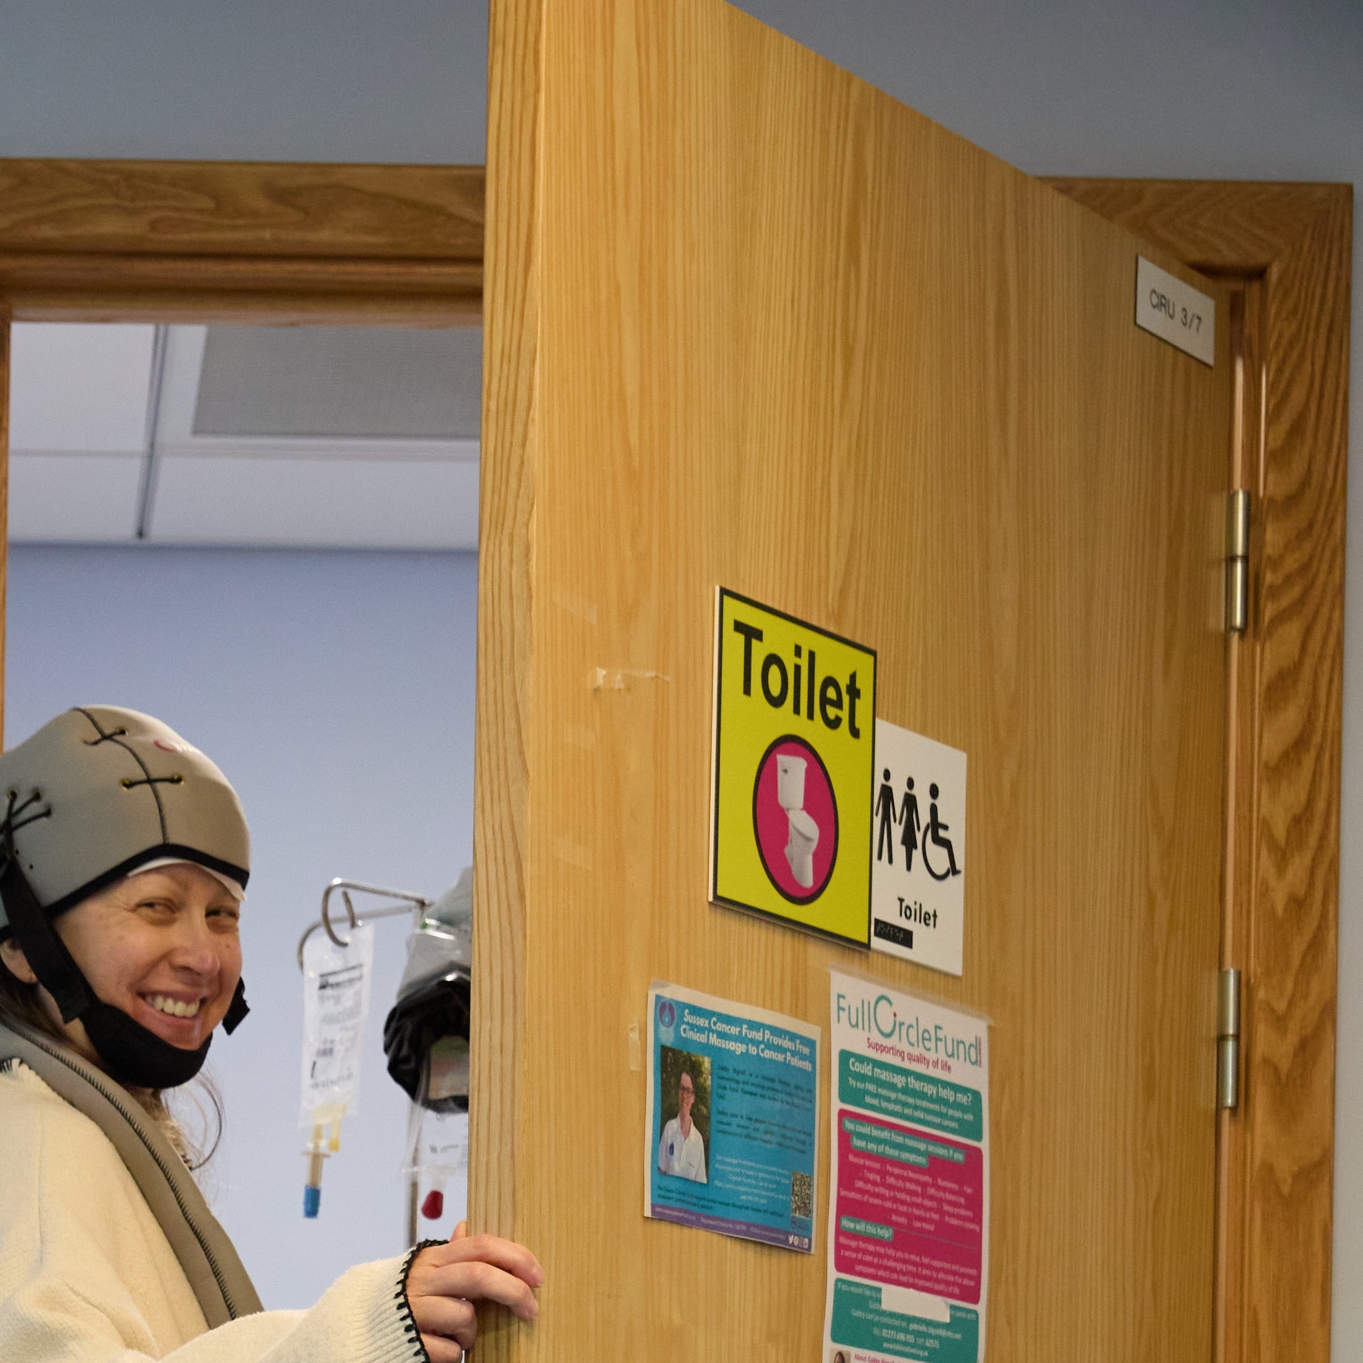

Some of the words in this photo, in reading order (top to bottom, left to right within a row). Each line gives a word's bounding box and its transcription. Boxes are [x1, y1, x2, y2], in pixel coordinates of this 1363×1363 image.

[1180, 308, 1202, 333] 3/7
[733, 619, 861, 739] Toilet
[897, 896, 938, 929] Toilet
[680, 1023, 707, 1044] Clinical
[708, 1032, 746, 1057] Massage
[748, 1042, 756, 1055] to
[758, 1043, 784, 1063] Cancer
[786, 1051, 811, 1072] Patients
[683, 1008, 708, 1028] Sussex
[710, 1016, 740, 1037] Cancer
[742, 1024, 762, 1042] Fund
[764, 1030, 794, 1050] Provides
[796, 1039, 809, 1056] Free
[866, 1037, 904, 1062] Supporting
[906, 1049, 930, 1070] quality
[931, 1057, 938, 1069] of
[940, 1060, 951, 1073] life
[849, 1057, 871, 1076] Could
[873, 1065, 906, 1089] massage
[908, 1075, 936, 1097] therapy
[938, 1084, 953, 1103] help
[956, 1090, 971, 1106] me?
[844, 1119, 854, 1130] You
[855, 1122, 870, 1134] could
[871, 1126, 890, 1140] benefit
[891, 1132, 903, 1143] from
[904, 1137, 926, 1152] massage
[953, 1151, 963, 1162] you
[852, 1136, 866, 1148] have
[866, 1142, 876, 1152] any
[877, 1142, 884, 1152] of
[884, 1144, 899, 1157] these
[899, 1150, 926, 1166] symptoms
[841, 1217, 854, 1229] How
[855, 1220, 865, 1231] will
[866, 1222, 876, 1234] this
[876, 1224, 892, 1240] help?
